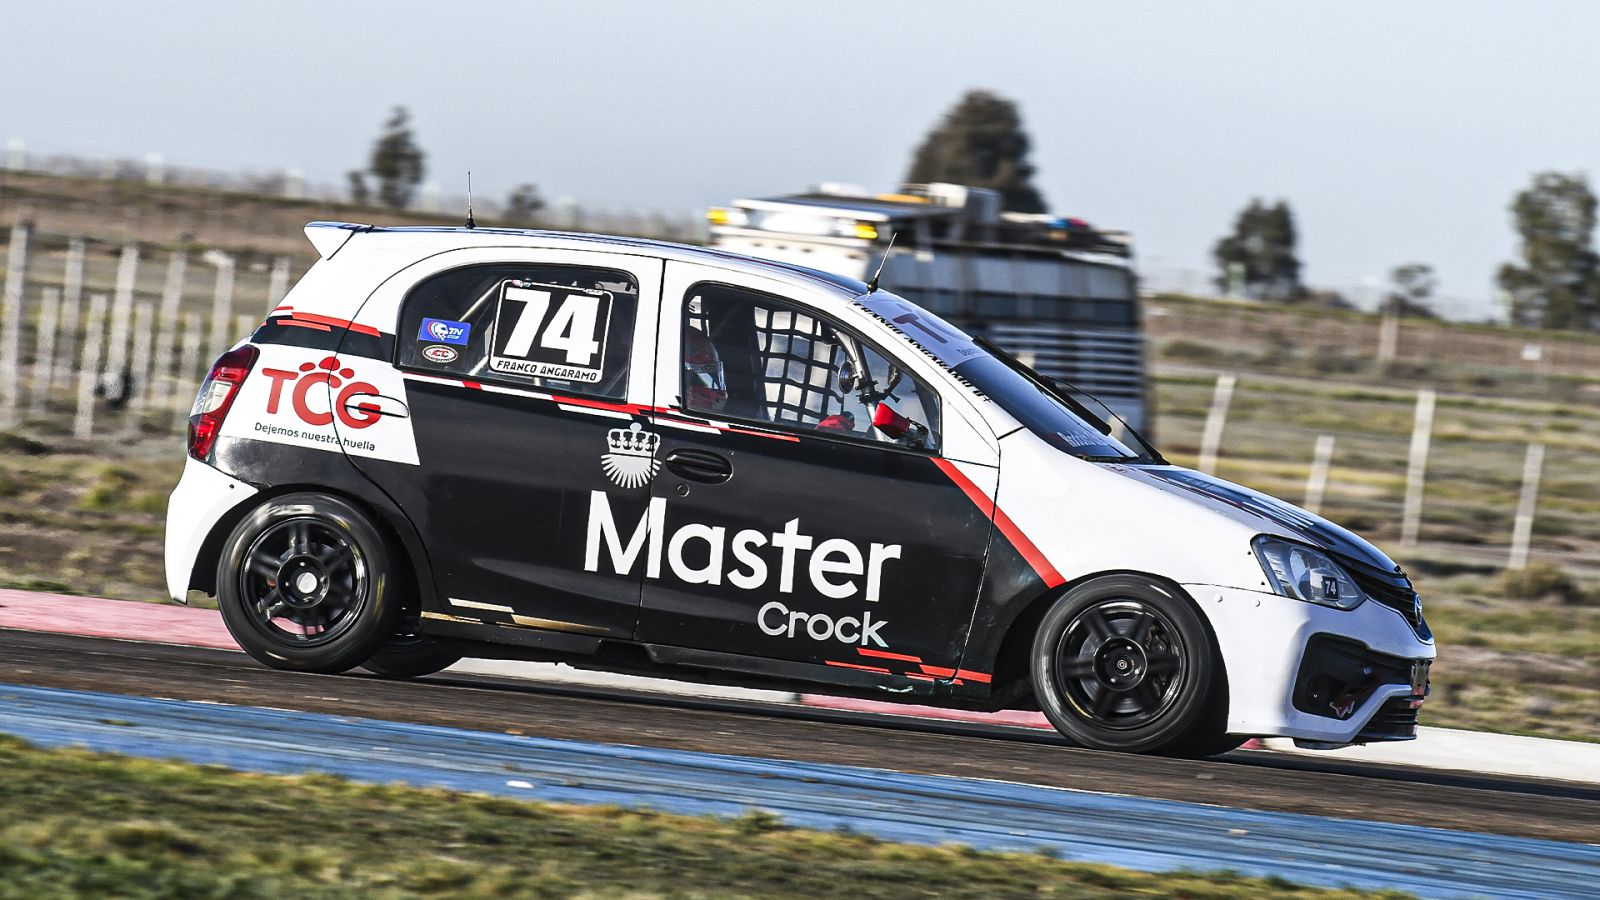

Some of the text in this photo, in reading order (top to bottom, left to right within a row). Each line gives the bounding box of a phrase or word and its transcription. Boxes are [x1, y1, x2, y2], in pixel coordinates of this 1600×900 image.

[503, 287, 600, 365] 74
[496, 360, 597, 381] FRANCO ANGARAMO
[262, 367, 382, 429] TCG
[254, 422, 376, 451] Dejemos nuestra huella
[584, 490, 902, 602] Master
[1325, 581, 1337, 594] 74
[757, 601, 889, 648] Crock
